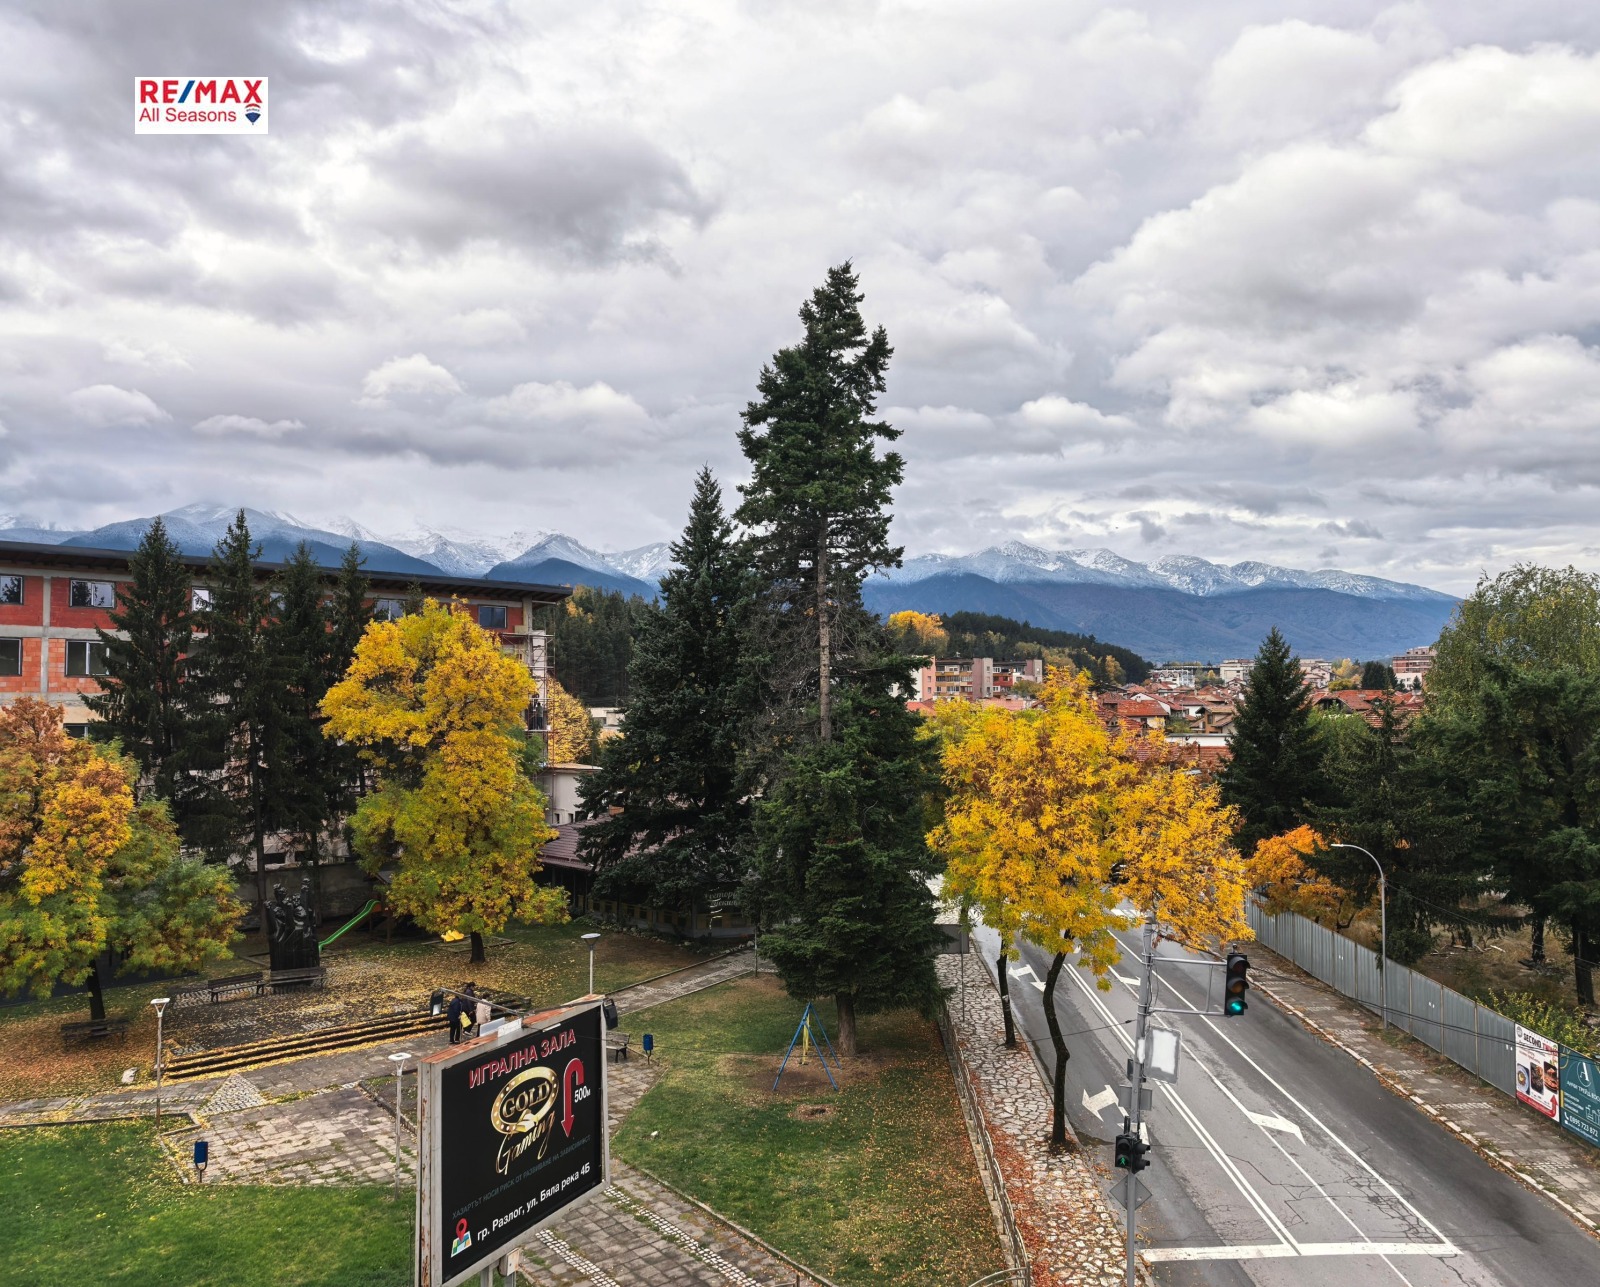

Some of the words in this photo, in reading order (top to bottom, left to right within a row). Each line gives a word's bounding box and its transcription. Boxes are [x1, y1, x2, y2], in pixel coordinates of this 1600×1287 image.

[469, 1044, 538, 1089] ИГРАЛНА
[541, 1029, 576, 1058] ЗАЛА
[502, 1080, 550, 1118] GOLD
[495, 1110, 556, 1175] Gaming
[477, 1227, 490, 1241] гр.
[492, 1205, 525, 1232] Разлог,
[526, 1197, 538, 1214] ул.
[540, 1183, 560, 1203] Бяла
[561, 1170, 579, 1191] река
[580, 1161, 591, 1181] 4Б
[499, 1178, 515, 1192] РИСК
[515, 1173, 522, 1183] ОТ
